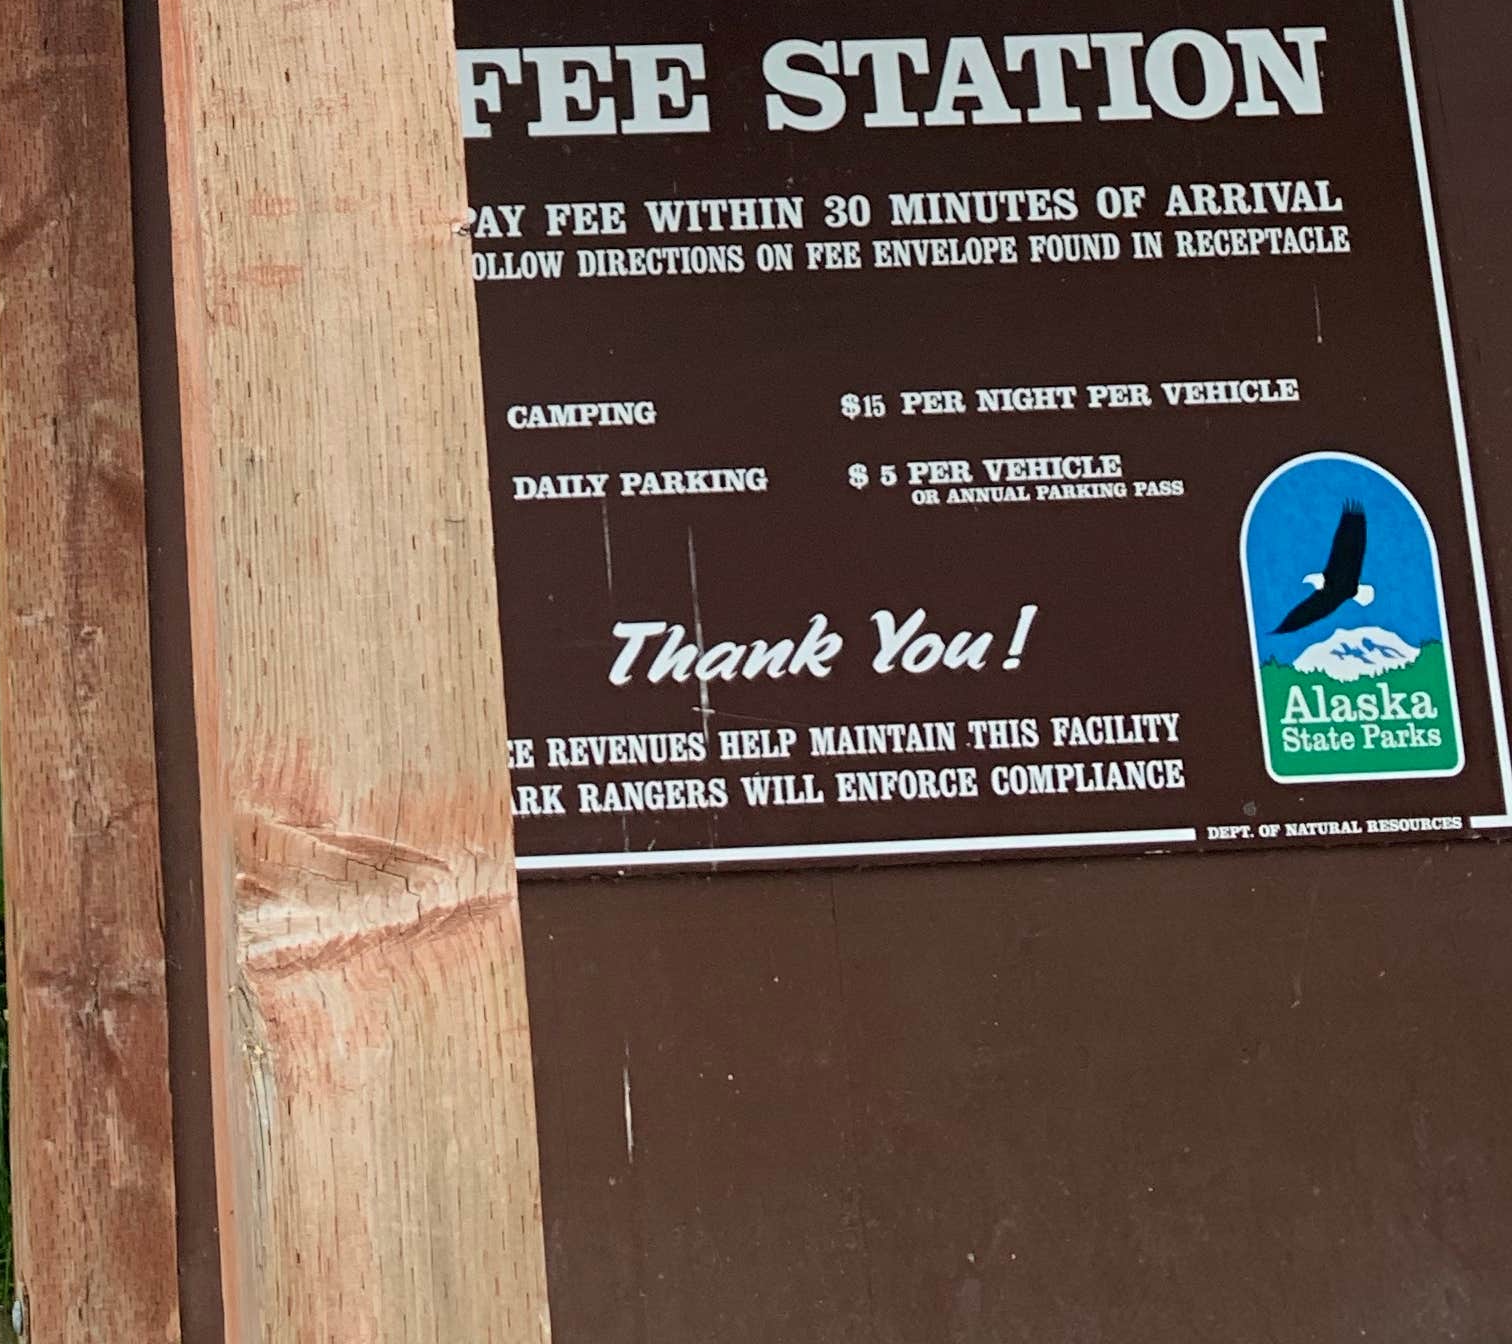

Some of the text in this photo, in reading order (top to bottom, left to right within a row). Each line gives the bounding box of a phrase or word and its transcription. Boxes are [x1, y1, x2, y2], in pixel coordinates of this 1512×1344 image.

[456, 27, 1326, 139] FEE STATION
[545, 203, 626, 236] FEE
[644, 197, 803, 232] WITHIN
[825, 195, 870, 227] 30
[889, 189, 1078, 225] MINUTES
[1097, 186, 1145, 219] OF
[1165, 181, 1342, 216] ARRIVAL
[472, 226, 1350, 281] OLLOW DIRECTIONS ON FEE ENVELOPE FOUND IN RECEPTACLE
[507, 402, 656, 429] CAMPING
[841, 379, 1299, 419] $15 PER NIGHT PER VEHICLE
[513, 468, 768, 500] DAILY PARKING
[907, 461, 973, 484] PER
[982, 455, 1122, 481] VEHICLE
[912, 479, 1185, 504] OR ANNUAL PARKING PASS
[609, 605, 1037, 686] Thank You!
[1281, 683, 1437, 724] Alaska
[546, 733, 708, 768] REVENUES
[718, 729, 796, 760] HELP
[809, 722, 955, 756] MAINTAIN
[967, 719, 1039, 749] THIS
[1051, 713, 1179, 746] FACILITY
[1282, 723, 1441, 752] State Parks
[578, 760, 1185, 812] RANGERS WILL ENFORCE COMPLIANCE
[1208, 817, 1462, 839] DEPT. OF NATURAL RESOURCES
